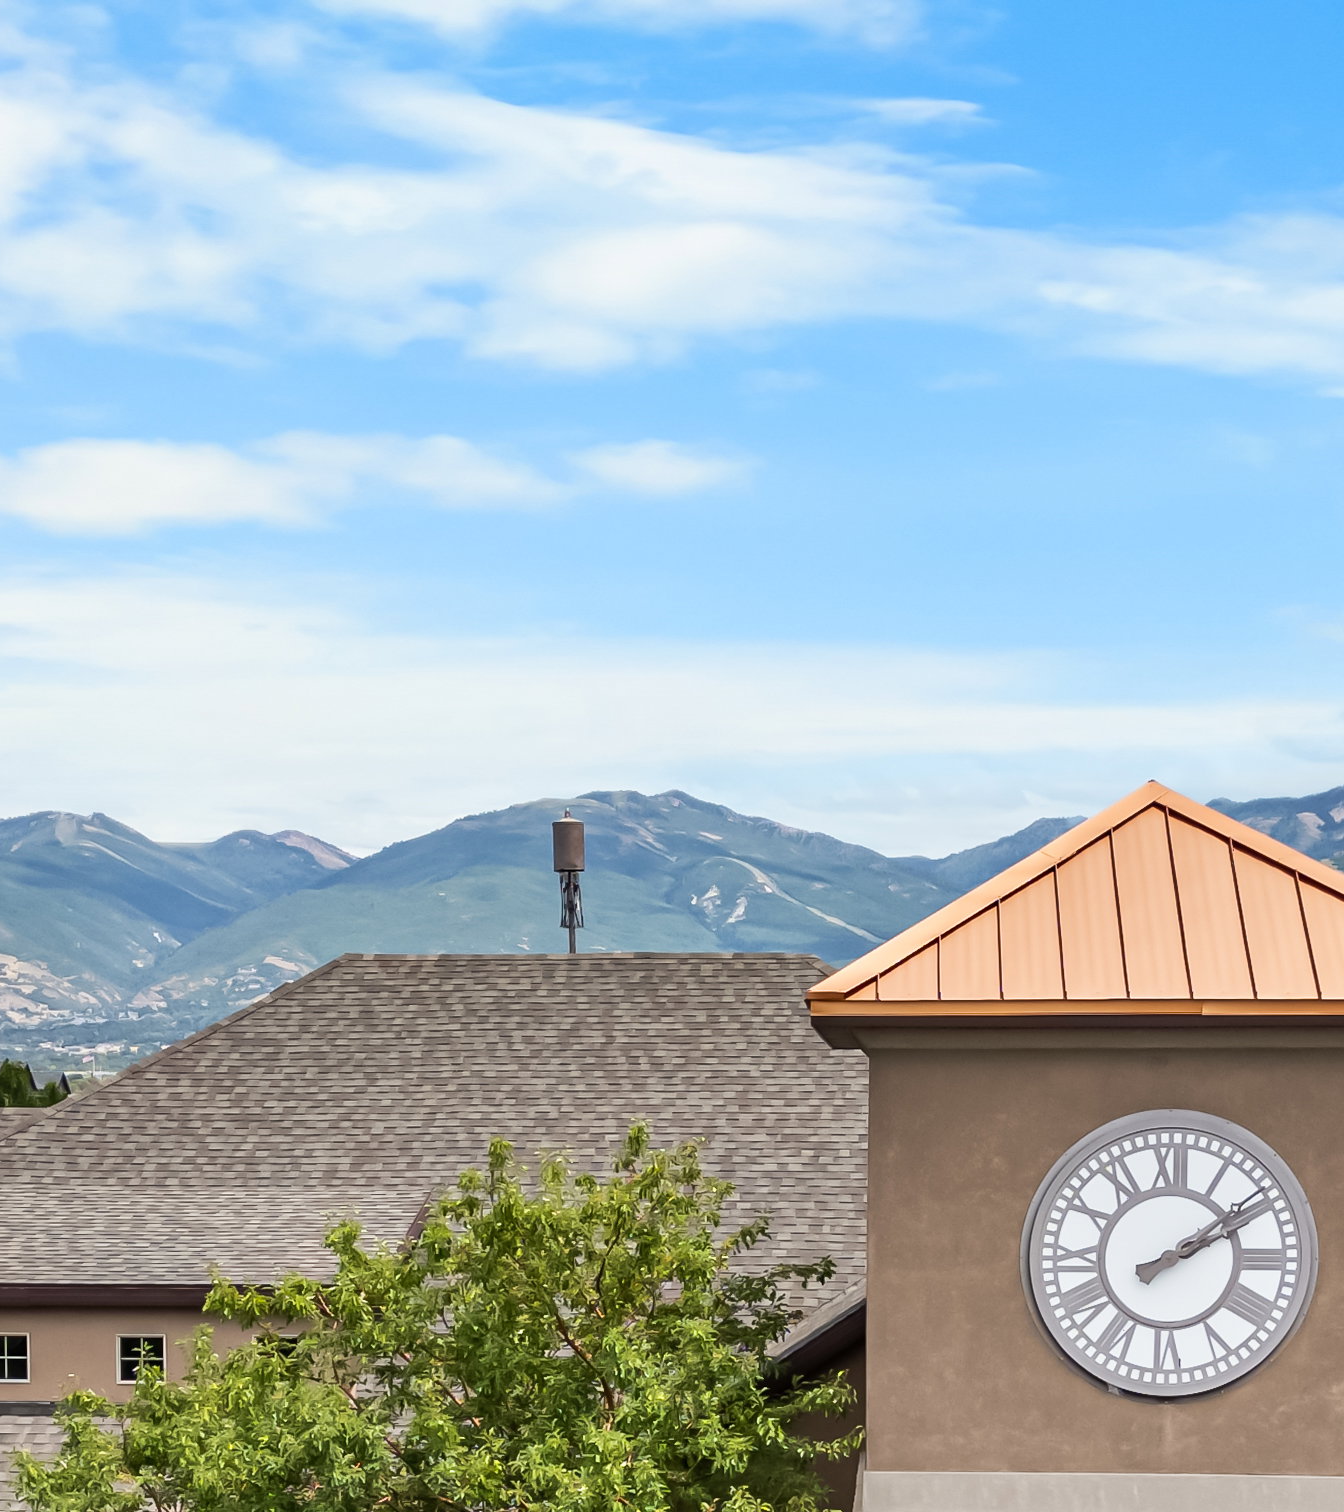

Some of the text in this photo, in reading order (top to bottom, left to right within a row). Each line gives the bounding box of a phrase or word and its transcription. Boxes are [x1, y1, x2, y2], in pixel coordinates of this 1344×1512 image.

[1099, 1157, 1142, 1206] XI
[1152, 1147, 1188, 1189] XII
[1205, 1159, 1232, 1198] I
[1068, 1191, 1113, 1231] X
[1056, 1244, 1098, 1272] IX
[1239, 1248, 1282, 1270] III
[1060, 1276, 1112, 1330] VIII
[1094, 1312, 1138, 1360] VII
[1154, 1329, 1180, 1368] VI
[1203, 1320, 1235, 1359] V
